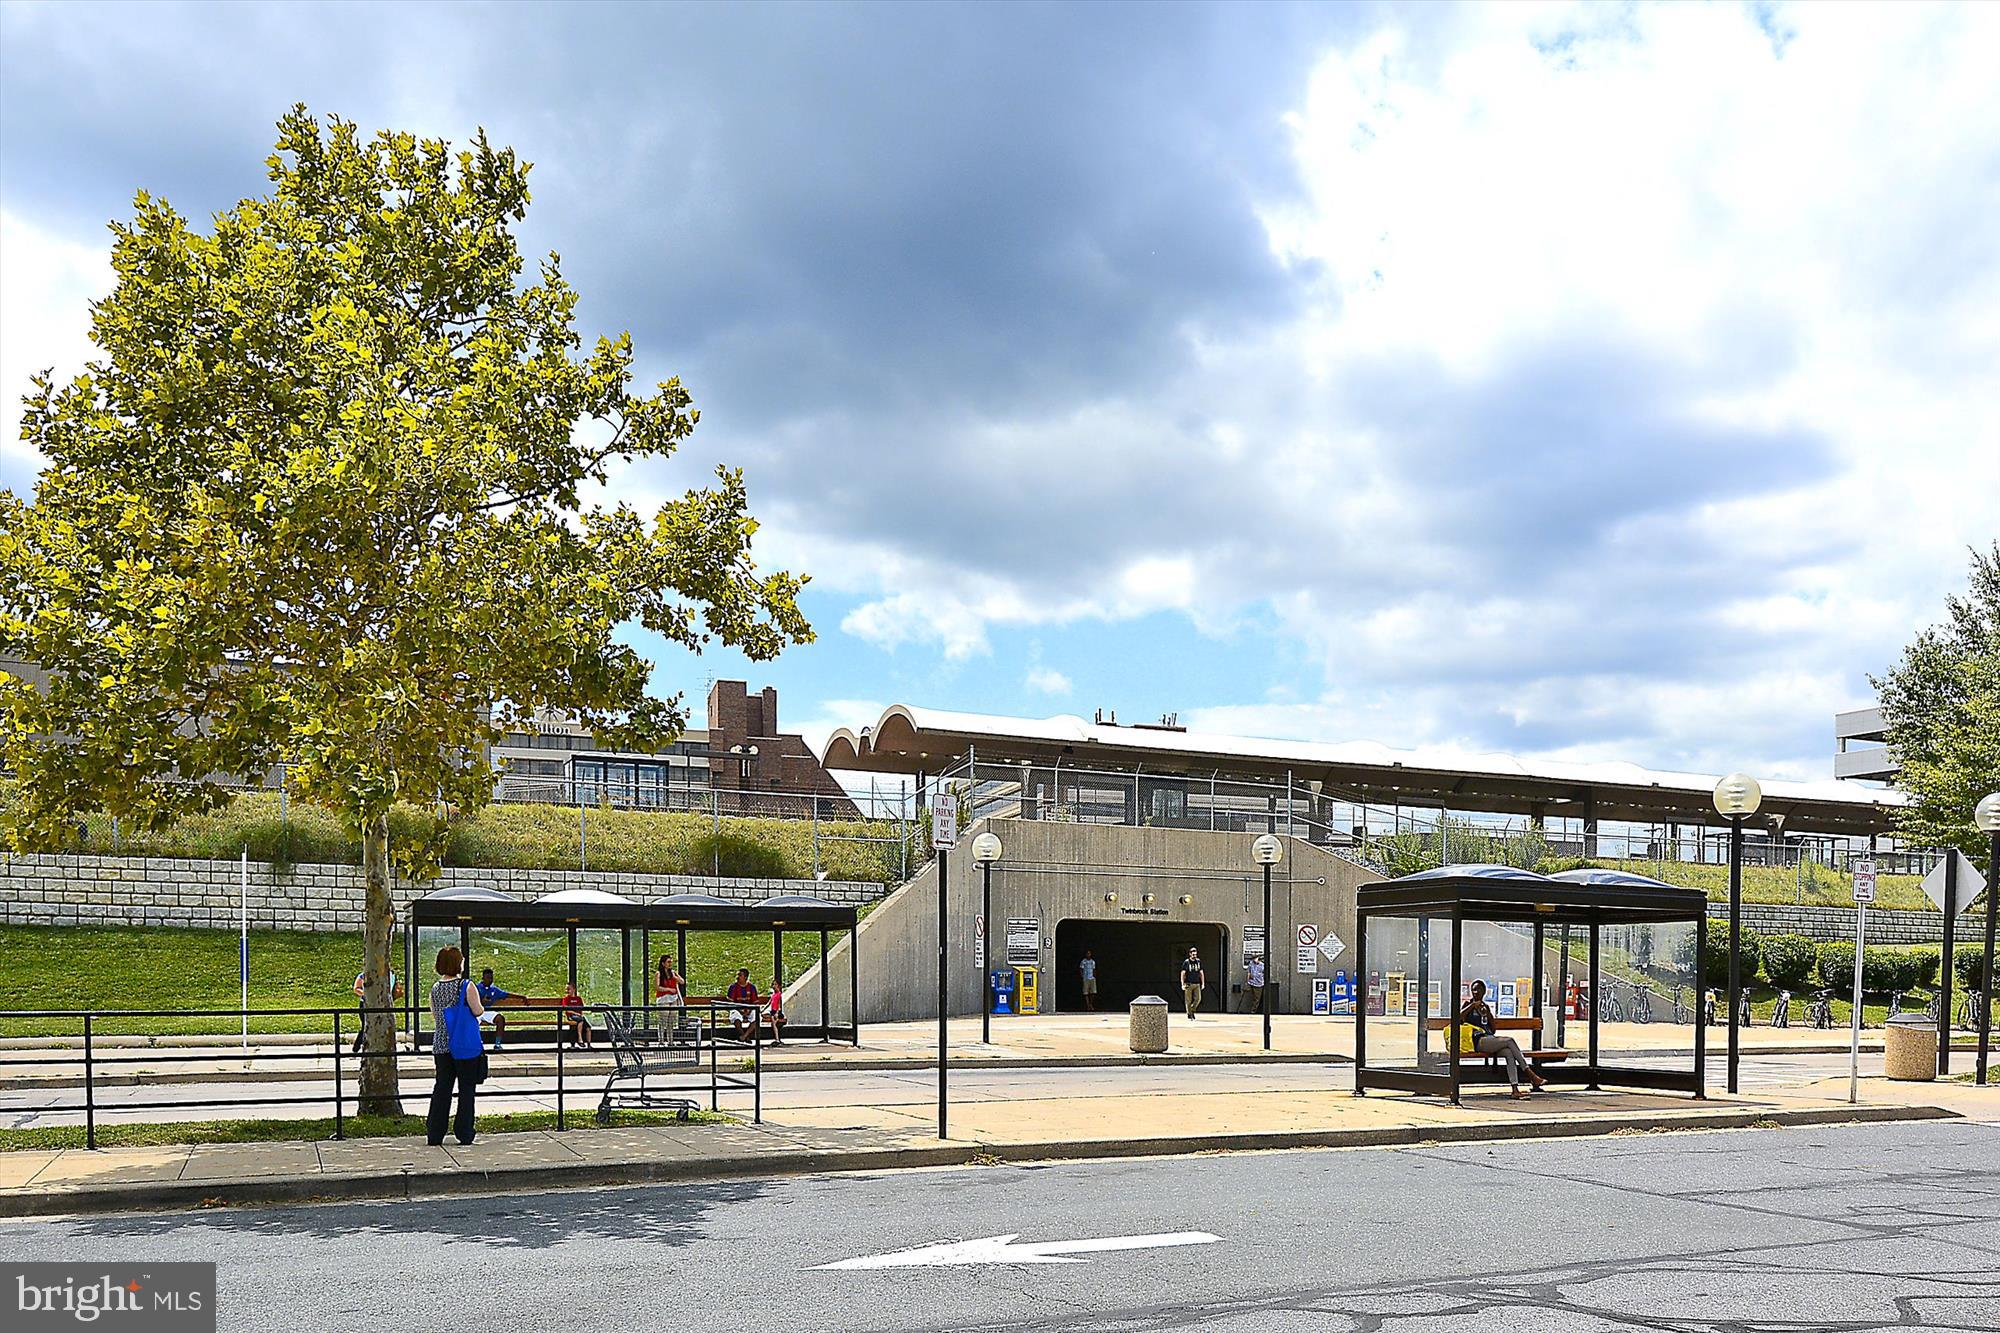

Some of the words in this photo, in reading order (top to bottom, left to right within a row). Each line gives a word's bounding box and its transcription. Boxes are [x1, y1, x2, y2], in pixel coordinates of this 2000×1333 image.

[941, 797, 949, 807] NO
[940, 818, 950, 828] ANY
[1860, 864, 1870, 873] NO
